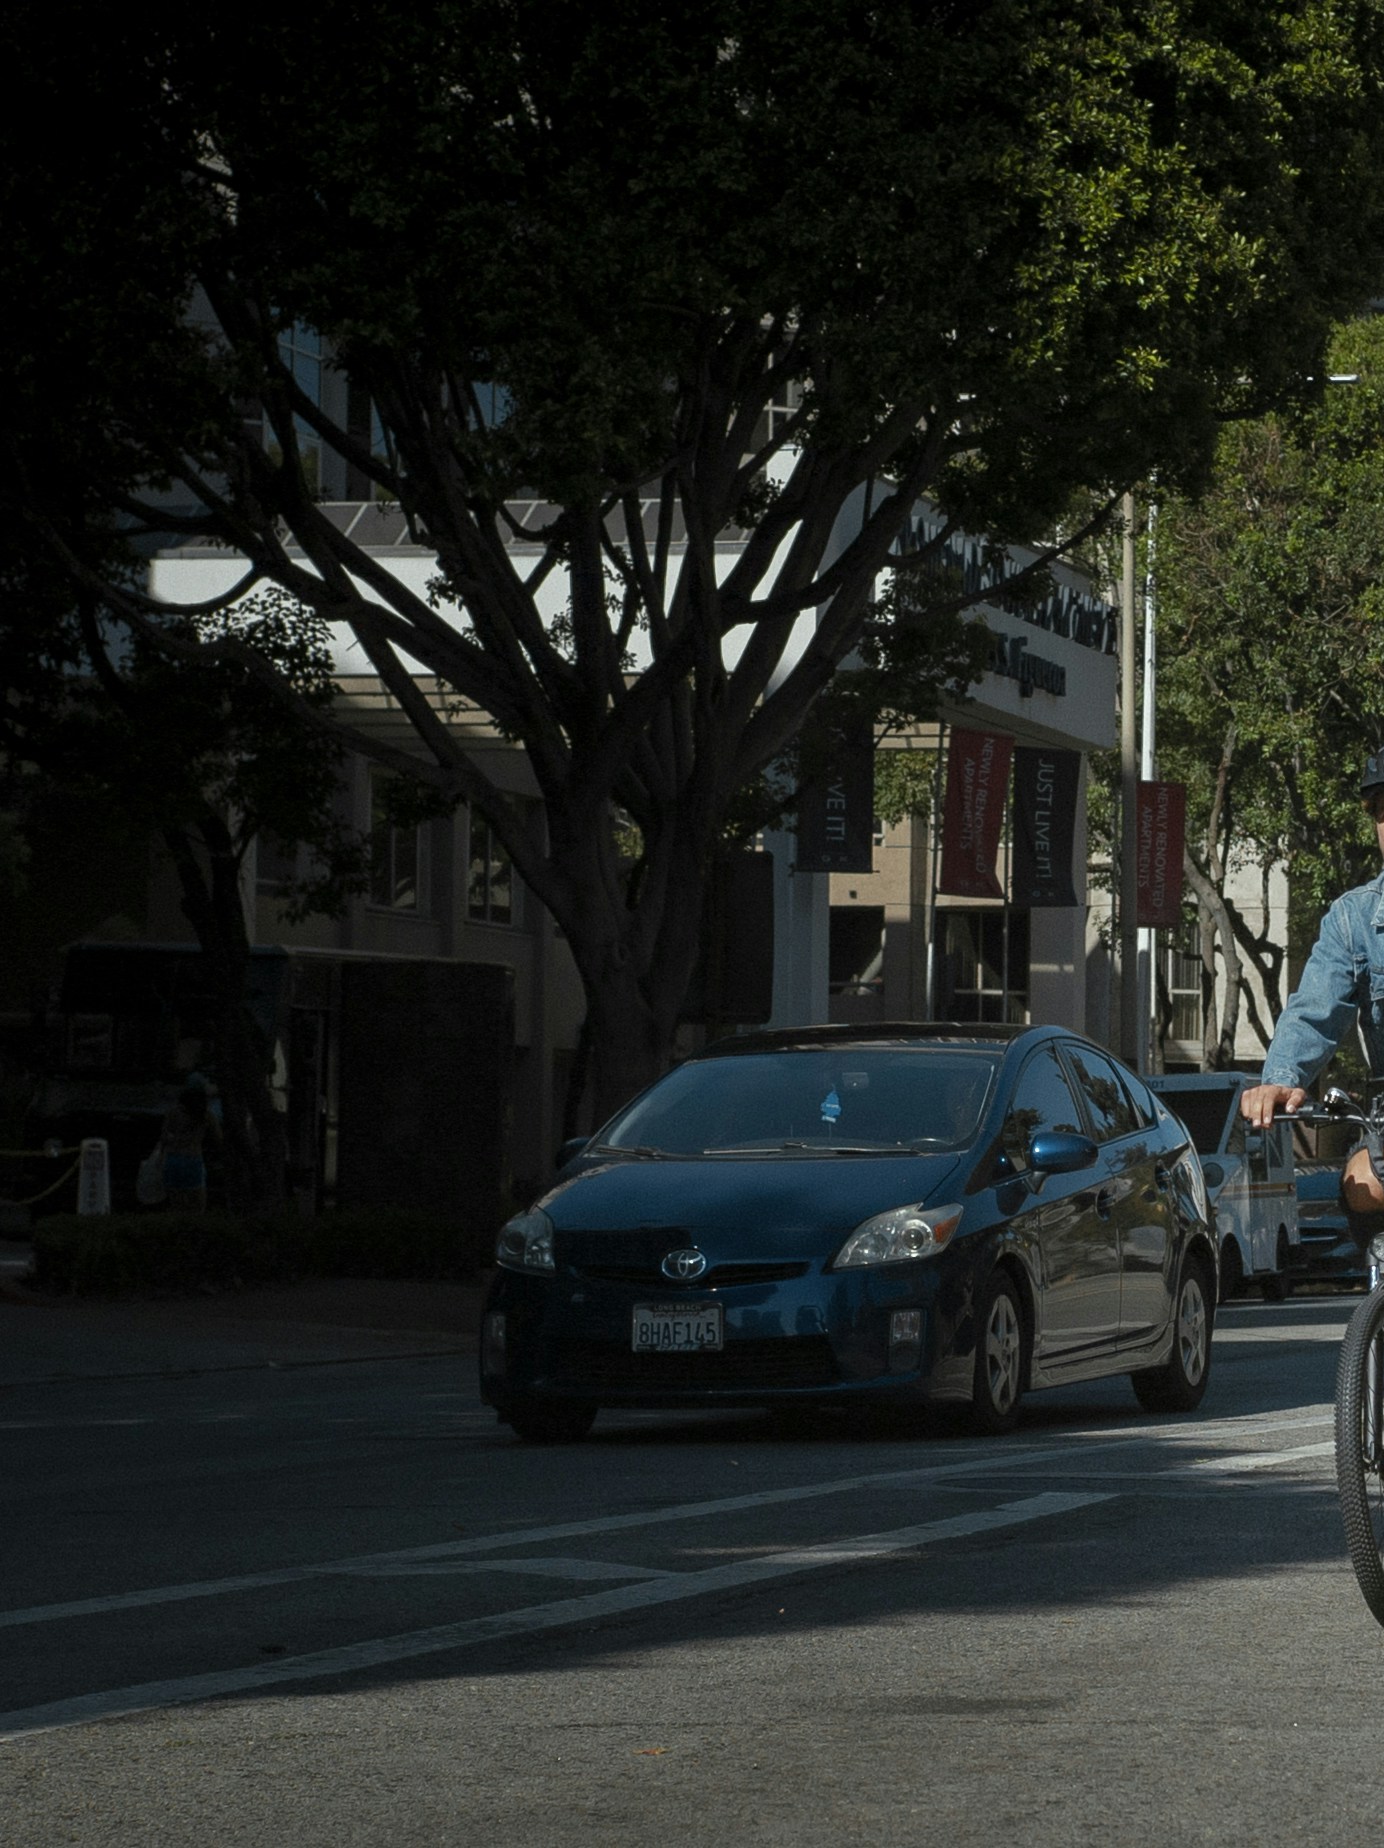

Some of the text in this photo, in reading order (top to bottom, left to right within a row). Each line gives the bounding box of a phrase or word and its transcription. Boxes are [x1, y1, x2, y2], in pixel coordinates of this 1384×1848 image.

[979, 737, 995, 787] NEWLY
[826, 816, 846, 841] IT!
[1035, 757, 1055, 878] JUST LIVE IT!
[1138, 806, 1152, 888] APARTMENTS
[1152, 786, 1169, 908] NEWLY RENOVATED
[639, 1322, 716, 1343] 8HAF145
